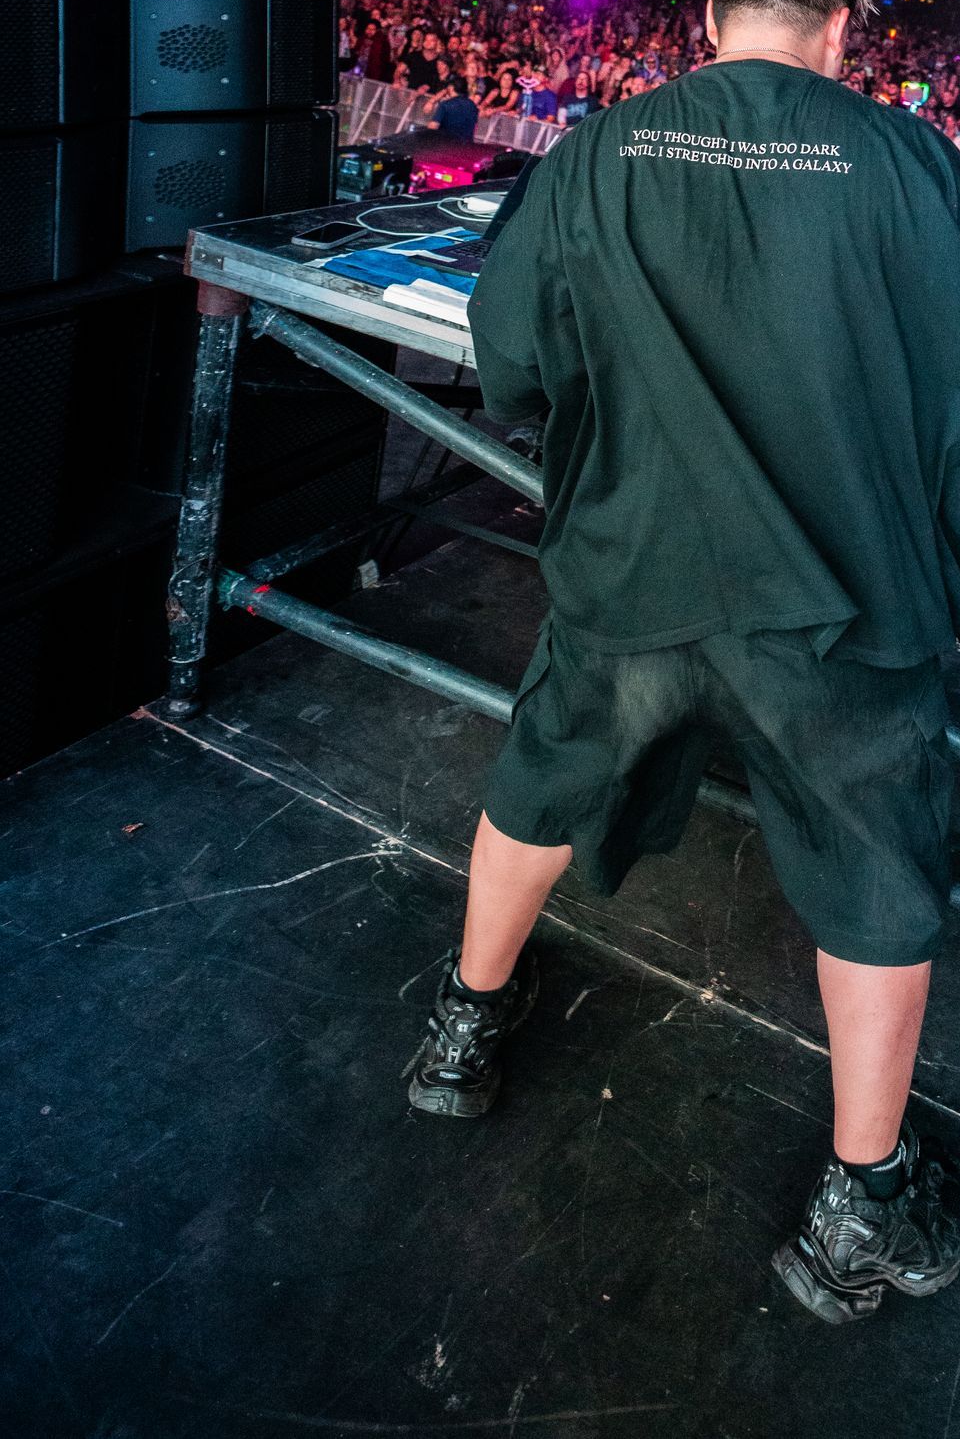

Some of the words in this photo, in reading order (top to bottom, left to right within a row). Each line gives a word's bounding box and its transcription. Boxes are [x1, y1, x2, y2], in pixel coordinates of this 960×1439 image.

[632, 129, 661, 142] YOU
[664, 131, 729, 149] THOUGHT
[730, 141, 736, 152] I
[738, 142, 767, 155] WAS
[769, 143, 797, 154] TOO
[800, 144, 841, 157] DARK
[619, 144, 656, 157] UNTIL
[658, 146, 664, 157] I
[666, 147, 743, 169] STRETCHED
[745, 158, 778, 171] INTO
[779, 159, 790, 170] A
[792, 159, 853, 174] GALAXY
